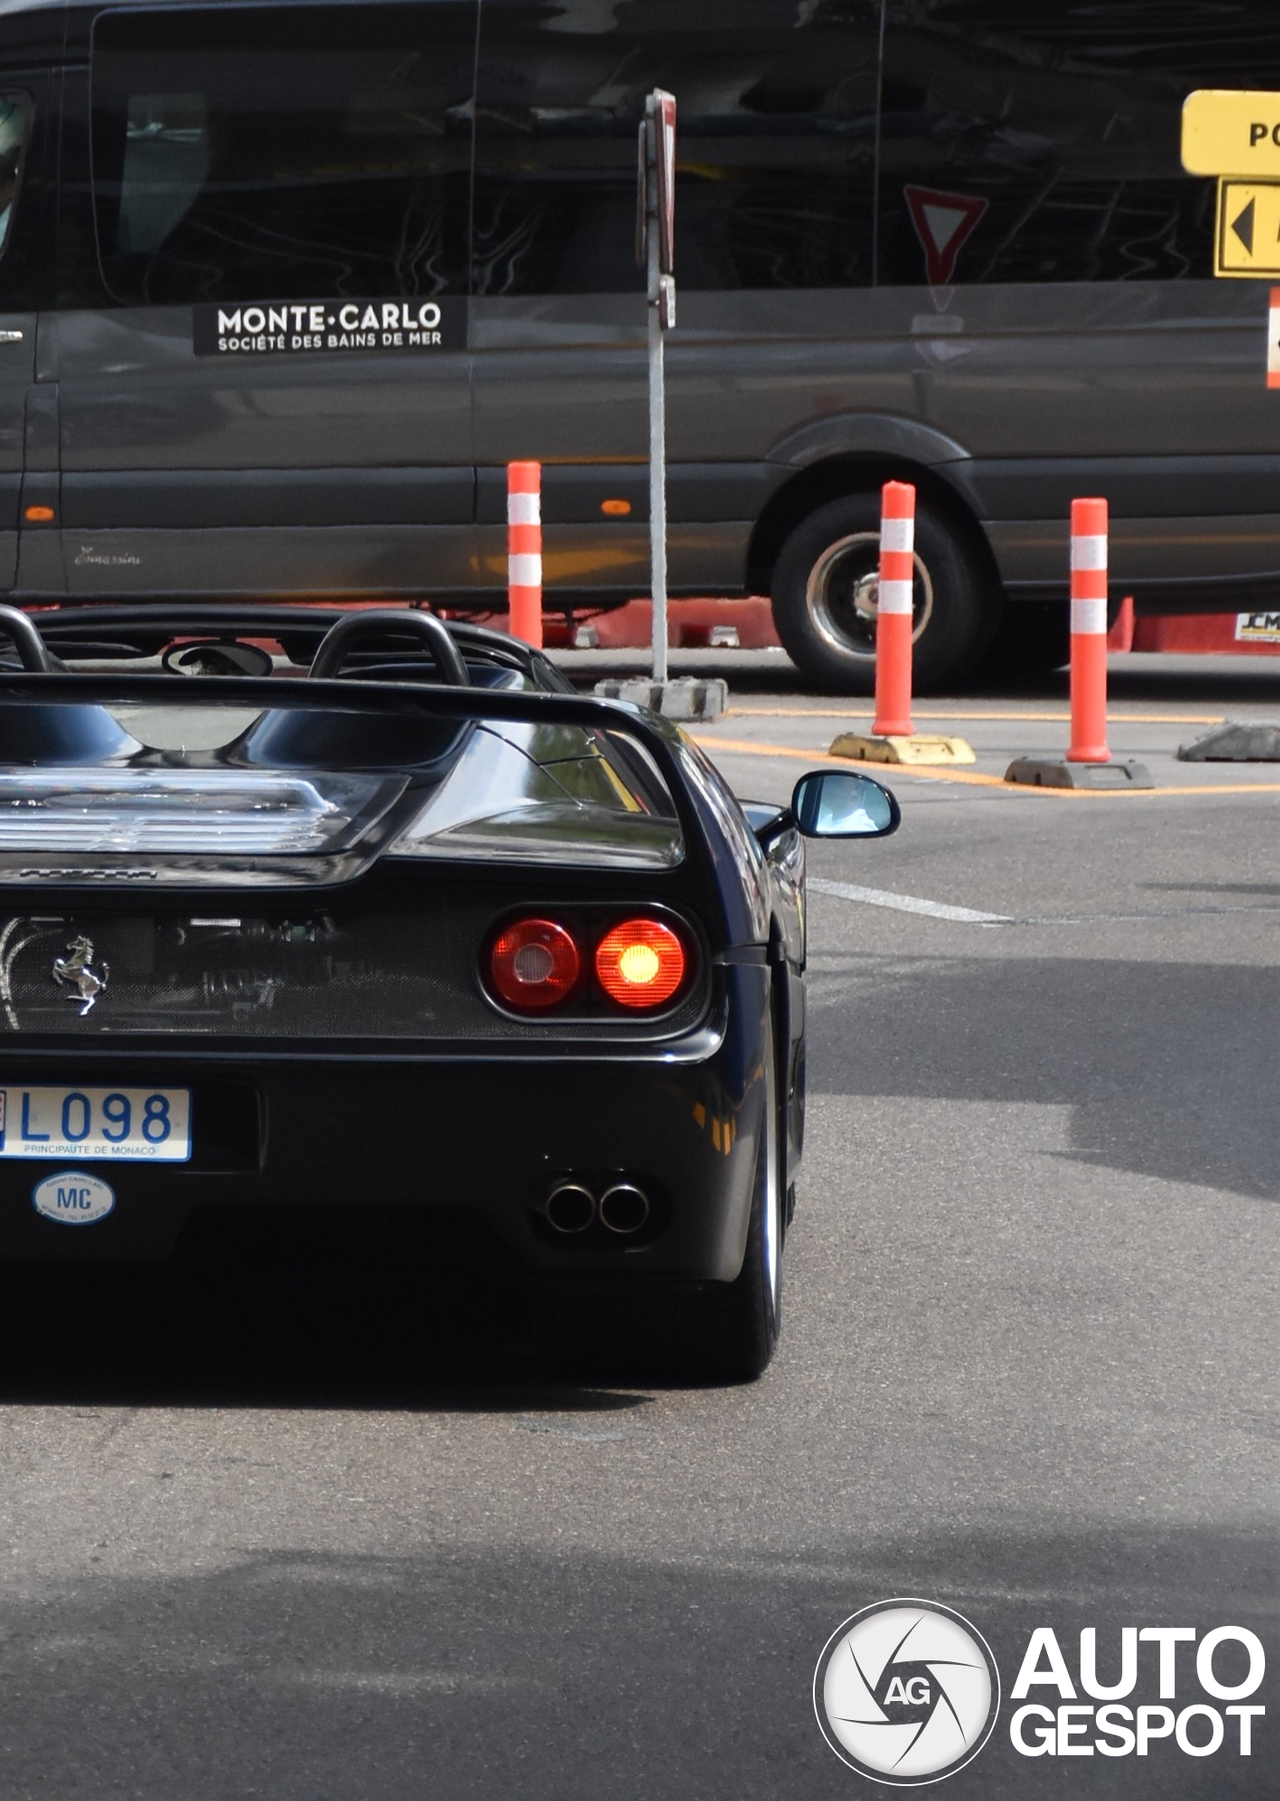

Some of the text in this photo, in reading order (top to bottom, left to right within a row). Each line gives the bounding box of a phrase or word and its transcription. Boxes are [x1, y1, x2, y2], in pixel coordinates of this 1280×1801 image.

[218, 331, 441, 351] SOCIÉTÉ DES BAINS DE MER
[21, 1092, 171, 1144] L098
[94, 1146, 108, 1154] DE
[112, 1146, 155, 1156] MONACO
[57, 1188, 91, 1209] MC
